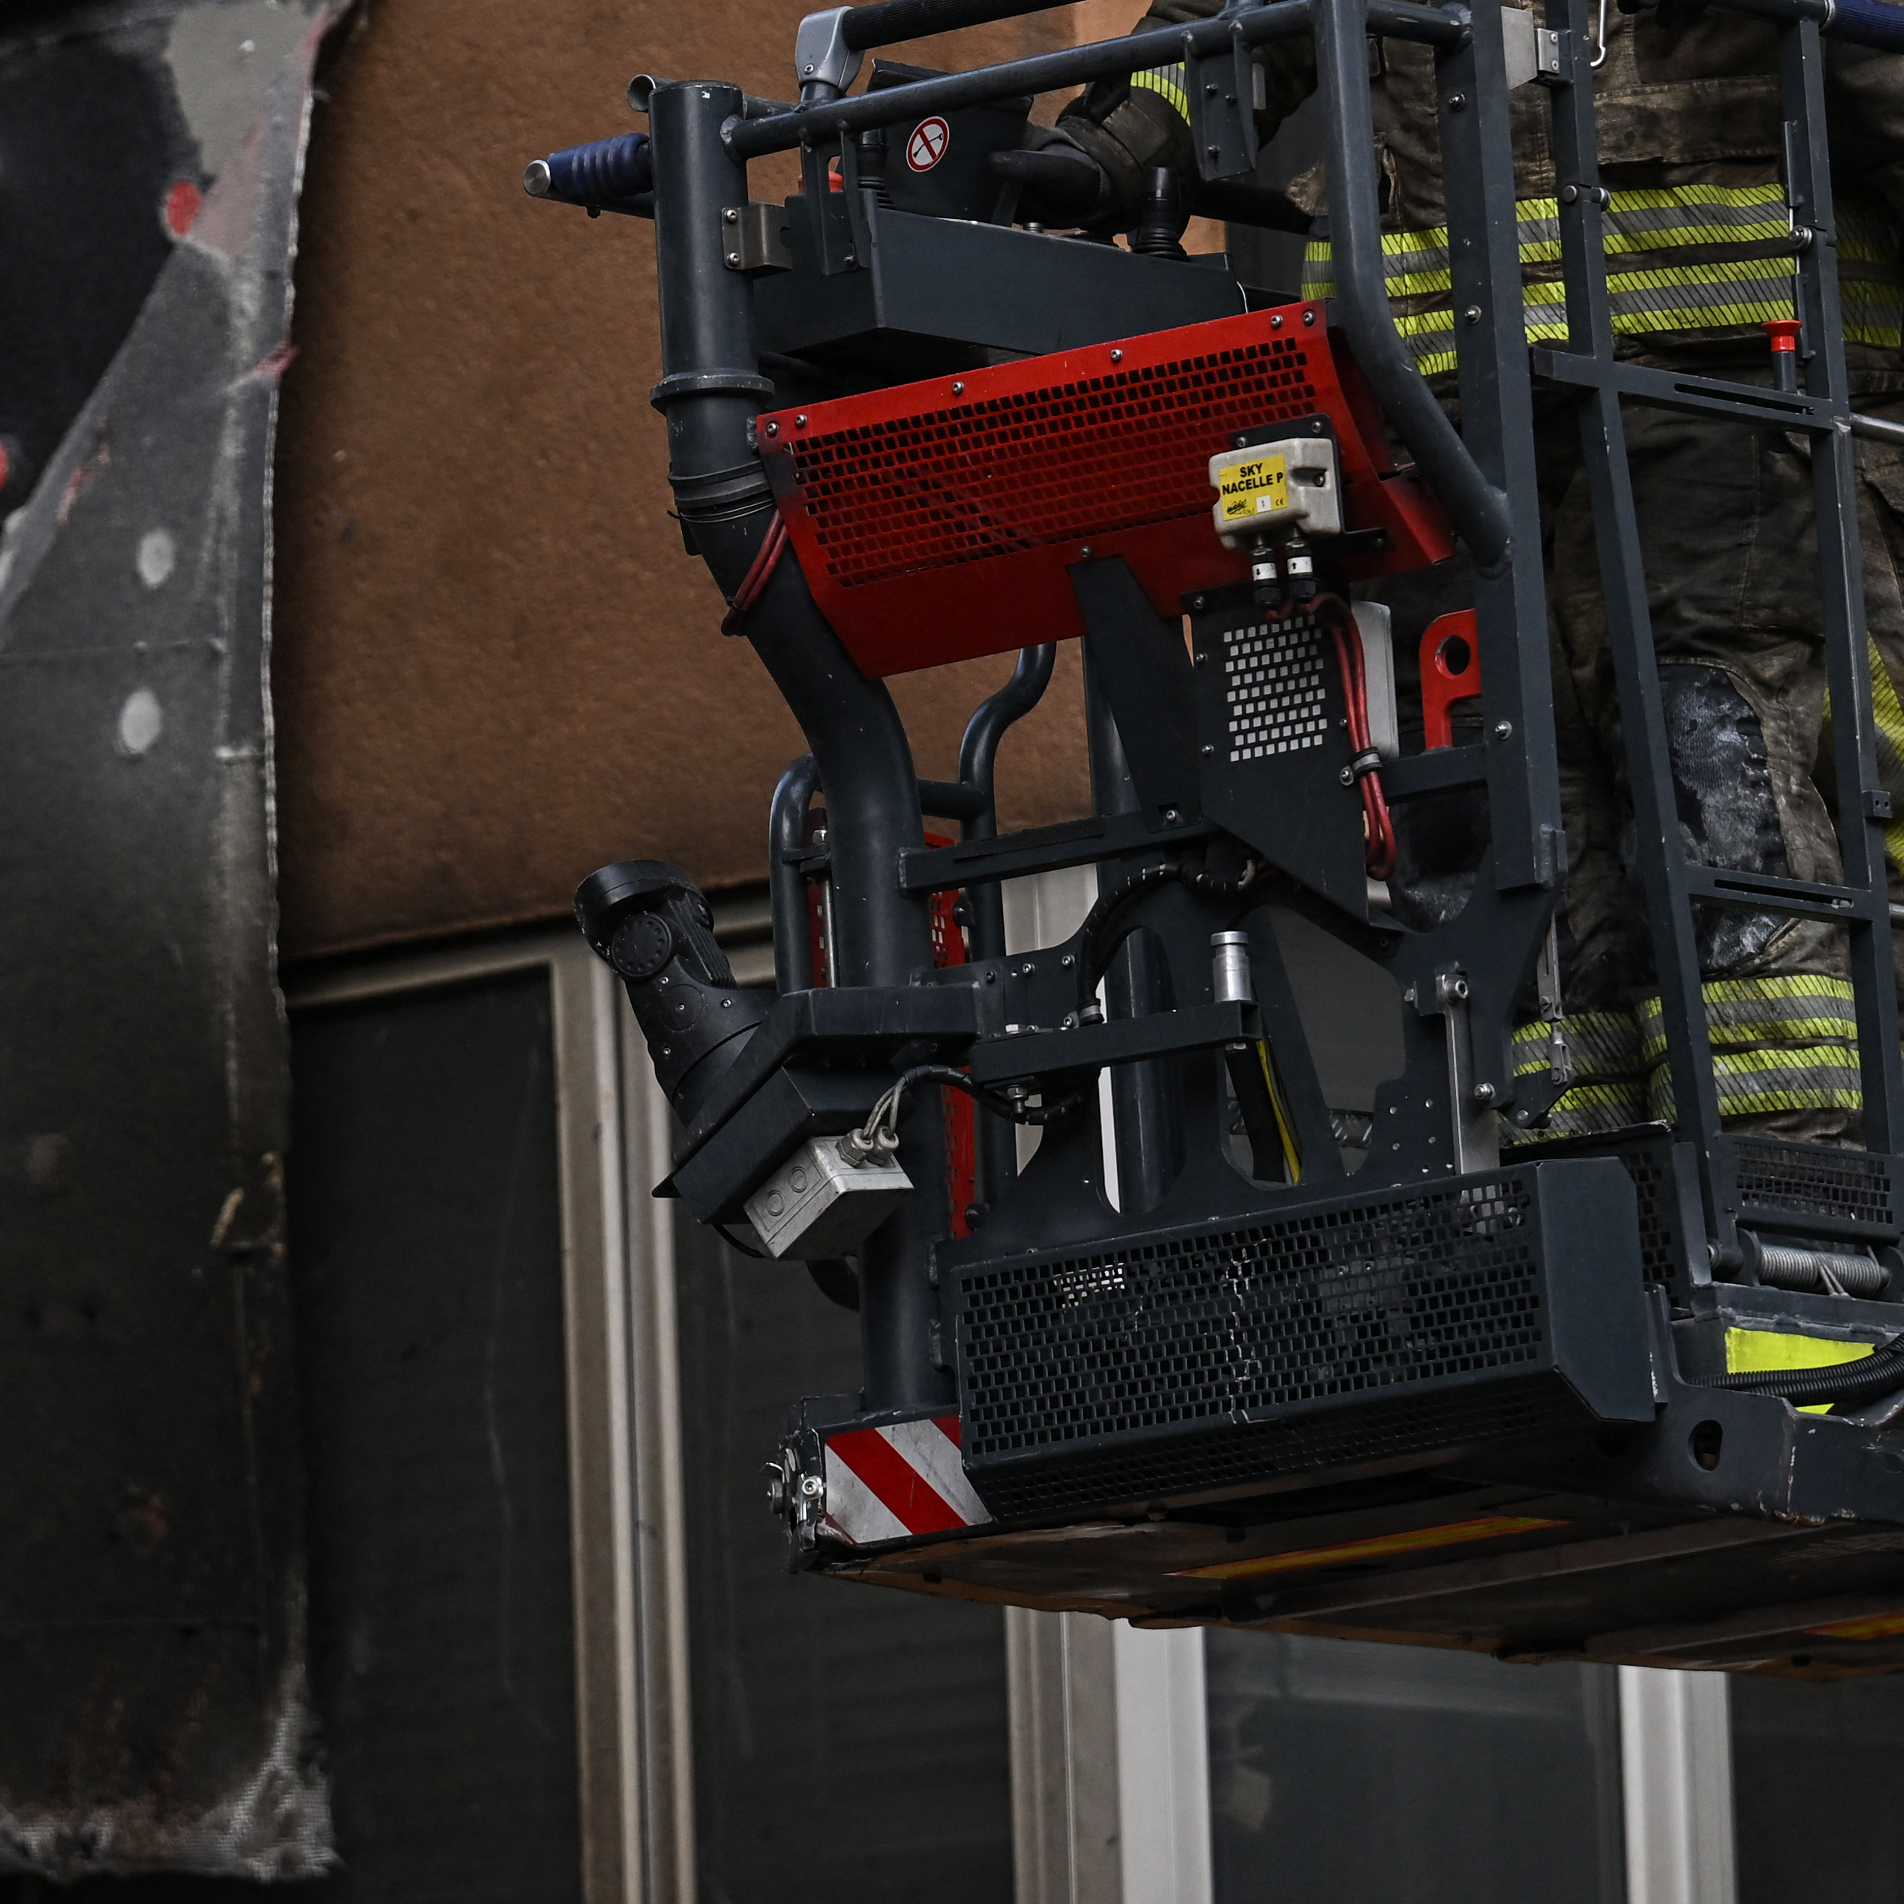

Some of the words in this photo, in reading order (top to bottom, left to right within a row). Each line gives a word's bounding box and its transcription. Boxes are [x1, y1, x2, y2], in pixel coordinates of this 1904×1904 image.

[1240, 463, 1262, 478] SKY
[1222, 475, 1273, 495] NACELLE
[1277, 472, 1283, 484] P
